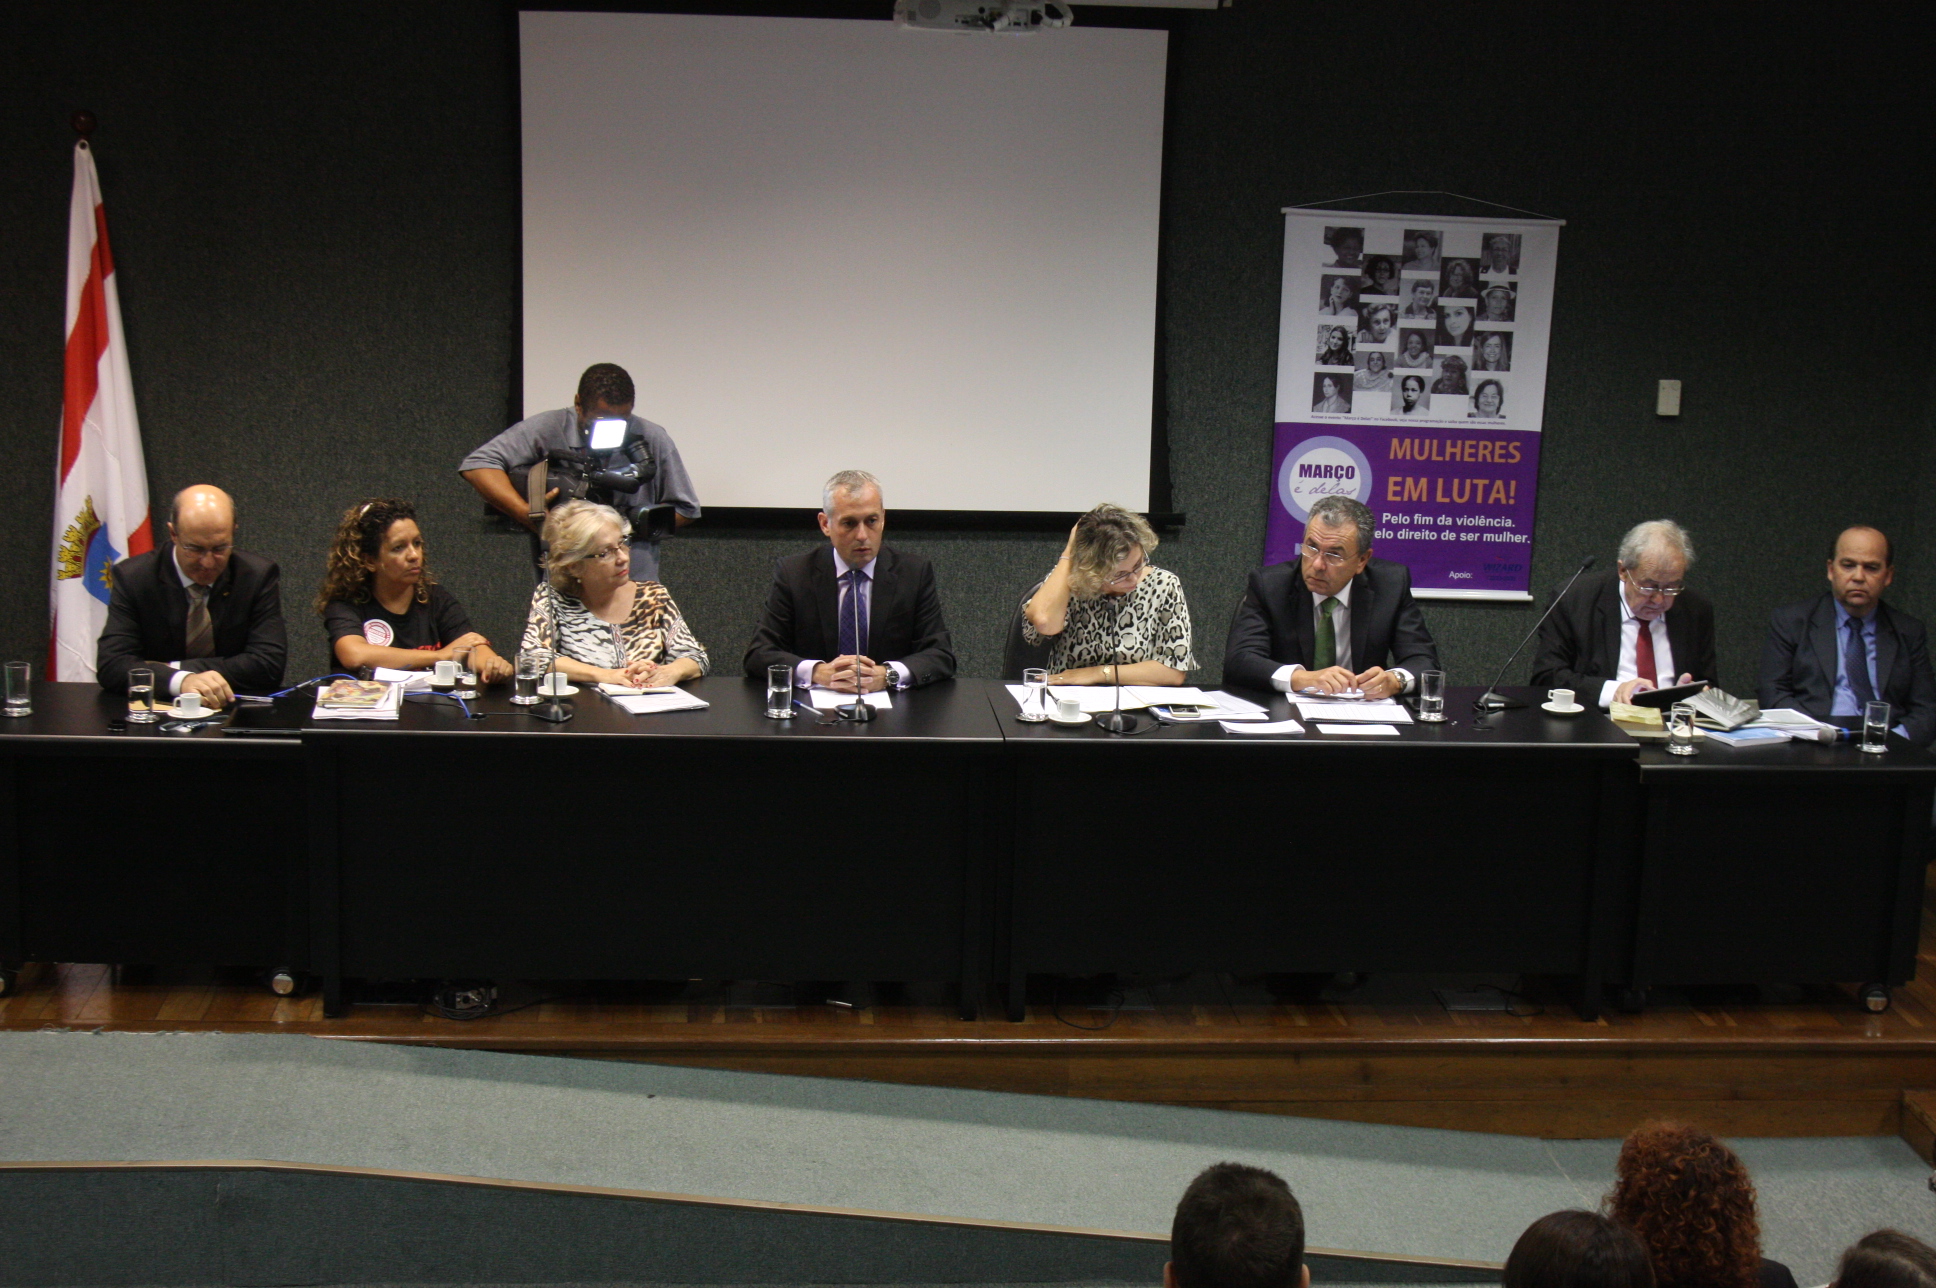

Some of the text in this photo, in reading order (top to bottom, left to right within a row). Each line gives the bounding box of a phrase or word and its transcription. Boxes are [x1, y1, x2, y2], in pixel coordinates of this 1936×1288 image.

[1390, 437, 1521, 463] MULHERES
[1299, 464, 1355, 482] MARÇO
[1309, 482, 1357, 495] delas
[1387, 476, 1516, 505] EM LUTA!
[1382, 513, 1516, 527] Pelo fim da violência.
[1375, 529, 1530, 544] elo direito de ser mulher.
[1449, 571, 1473, 580] Apoio:
